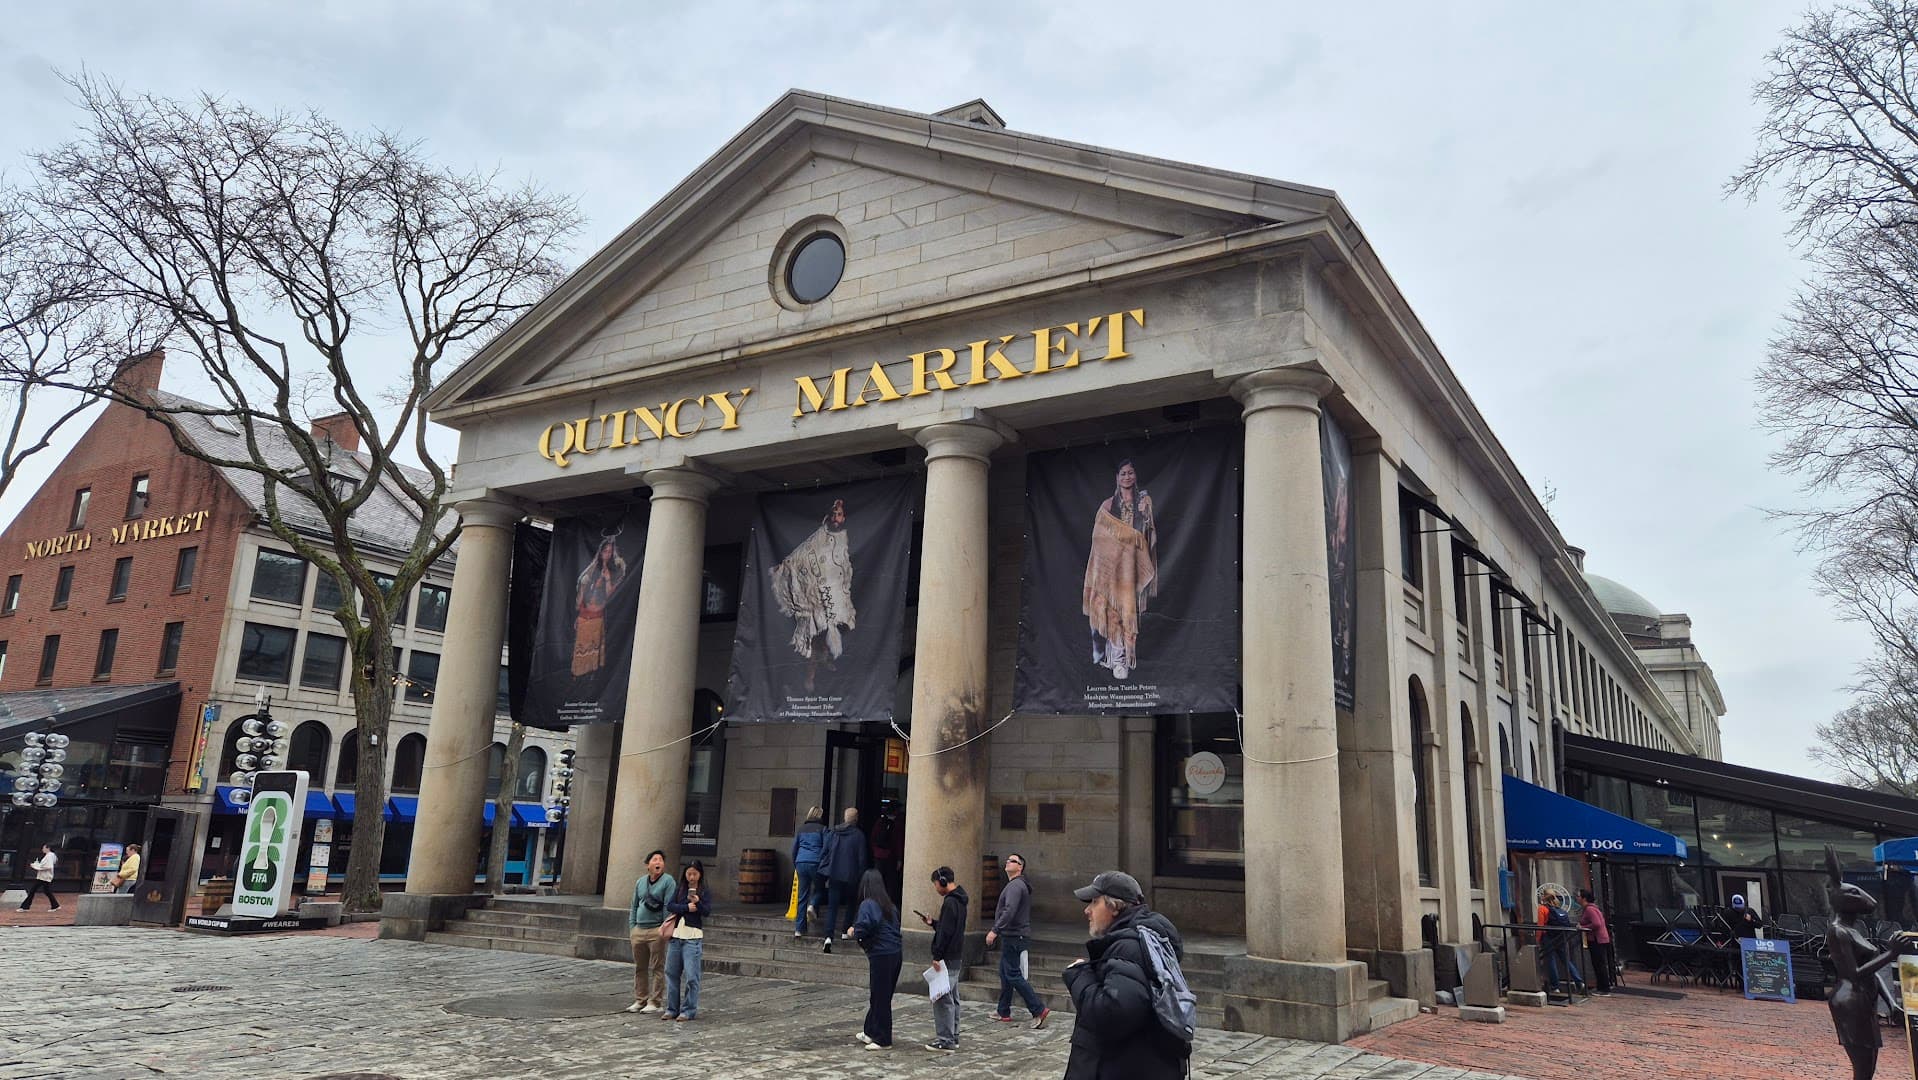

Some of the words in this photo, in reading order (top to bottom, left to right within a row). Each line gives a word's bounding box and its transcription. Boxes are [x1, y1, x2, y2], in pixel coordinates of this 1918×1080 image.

[538, 388, 751, 468] QUINCY
[793, 308, 1145, 417] MARKET
[110, 510, 209, 545] MARKET
[1545, 838, 1587, 849] SALTY
[1591, 839, 1623, 850] DOG
[251, 872, 268, 884] FIFA
[238, 895, 274, 906] BOSTON
[262, 920, 300, 928] #WEARE26
